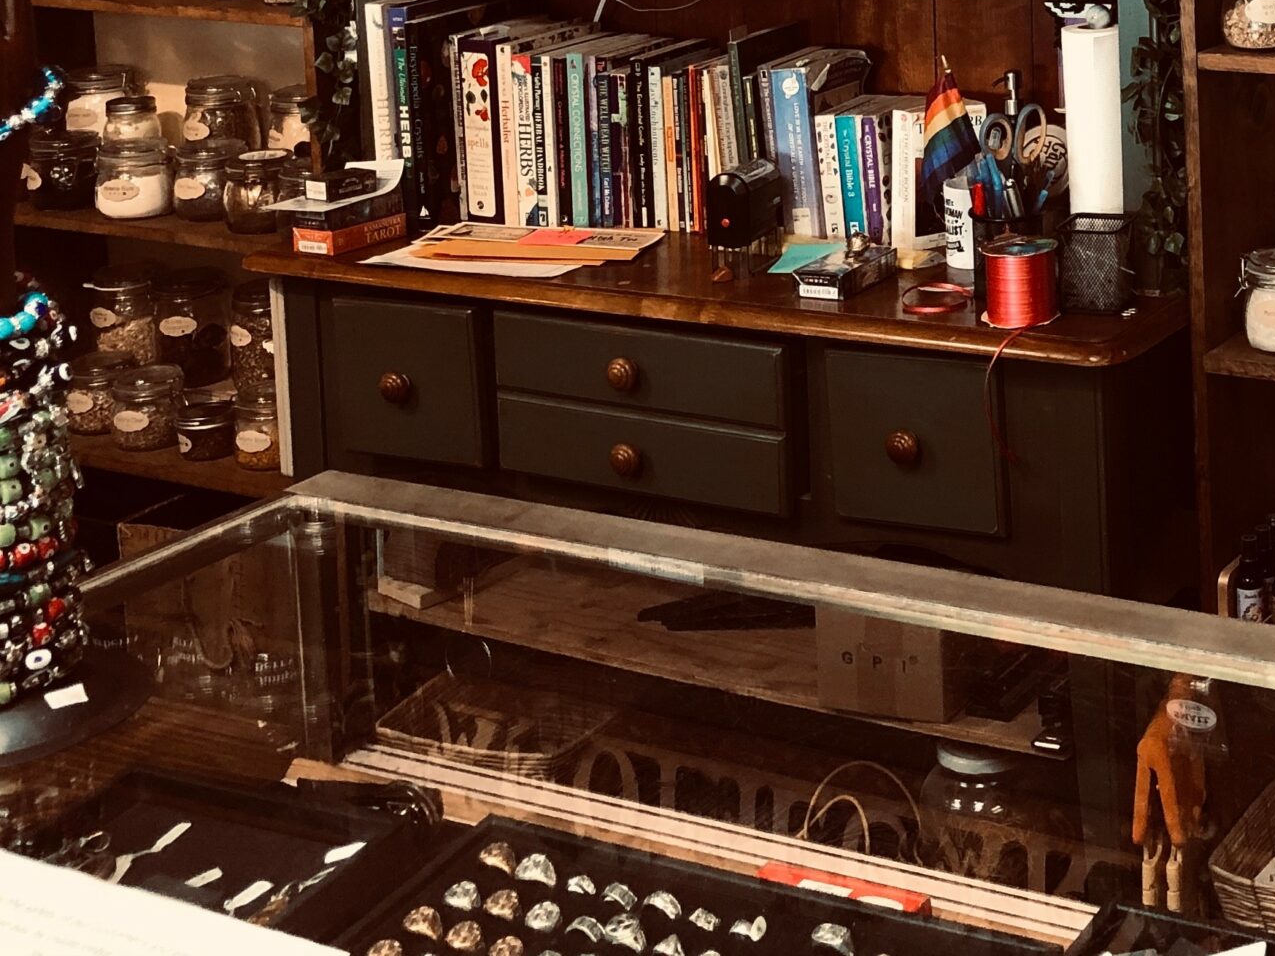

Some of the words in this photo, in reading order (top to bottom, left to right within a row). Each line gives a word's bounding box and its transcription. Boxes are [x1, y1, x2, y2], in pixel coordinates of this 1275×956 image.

[396, 57, 405, 71] The
[397, 72, 407, 105] Ultimate
[409, 45, 420, 109] Encyclopedia
[415, 118, 424, 159] Crystals
[568, 73, 579, 108] CRYSTAL
[600, 80, 608, 95] THE
[500, 100, 511, 144] Herbalist
[601, 98, 609, 122] WELL
[636, 94, 644, 125] Enchanted
[399, 106, 412, 159] HERB
[534, 112, 543, 146] HERBAL
[571, 110, 584, 174] CONNECTIONS
[601, 123, 609, 145] READ
[651, 104, 659, 166] Enchantments
[725, 122, 734, 164] Encyclopedia
[518, 122, 534, 177] HERBS
[602, 146, 610, 173] WITCH
[843, 139, 852, 168] Crystal
[864, 134, 874, 168] CRYSTAL
[537, 148, 547, 191] HANDBOOK
[846, 169, 854, 190] Bible
[868, 169, 876, 189] BIBLE
[365, 225, 401, 244] TAROT
